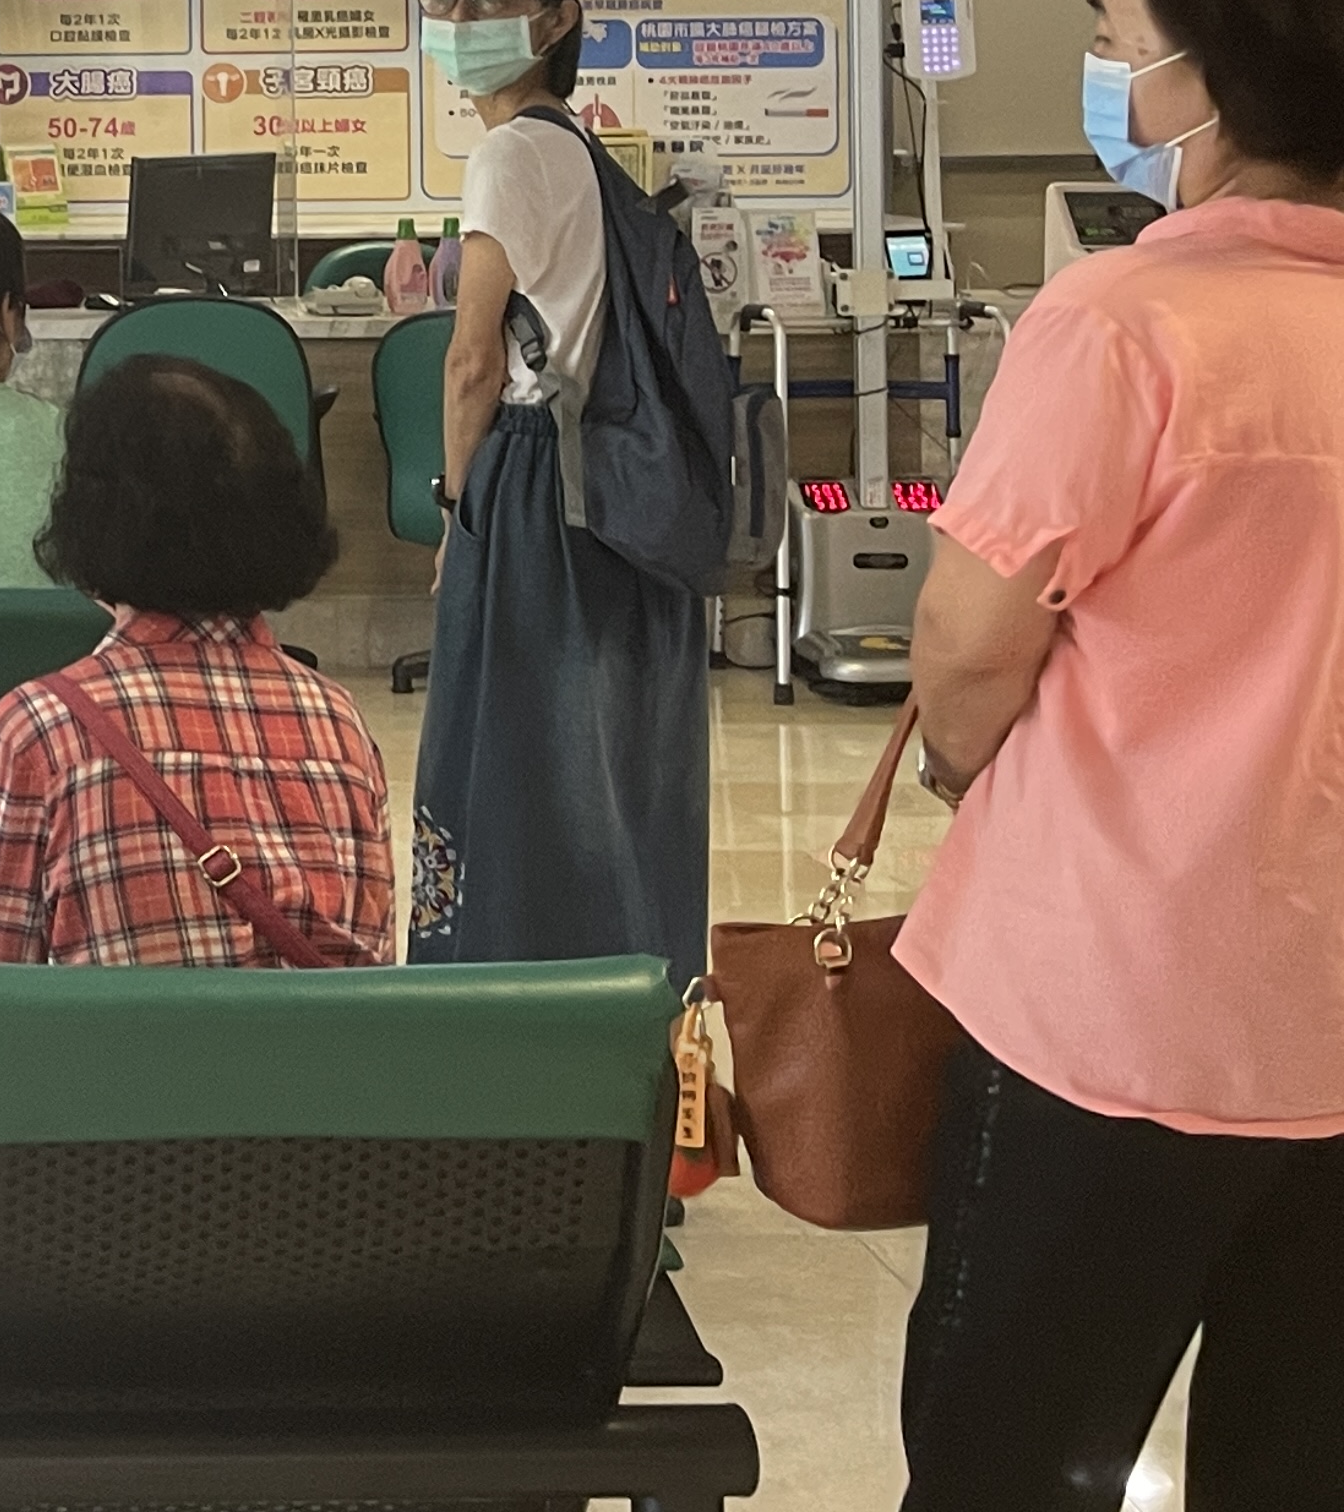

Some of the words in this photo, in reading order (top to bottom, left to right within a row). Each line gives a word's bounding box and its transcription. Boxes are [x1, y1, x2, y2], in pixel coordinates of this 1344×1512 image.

[59, 13, 121, 27] 每2年1次
[52, 67, 134, 96] 大腸癌
[262, 64, 370, 94] 子宮頸癌
[47, 117, 136, 139] 50-74歲
[62, 147, 125, 160] 每2年1次
[60, 163, 132, 177] 便潛血檢查
